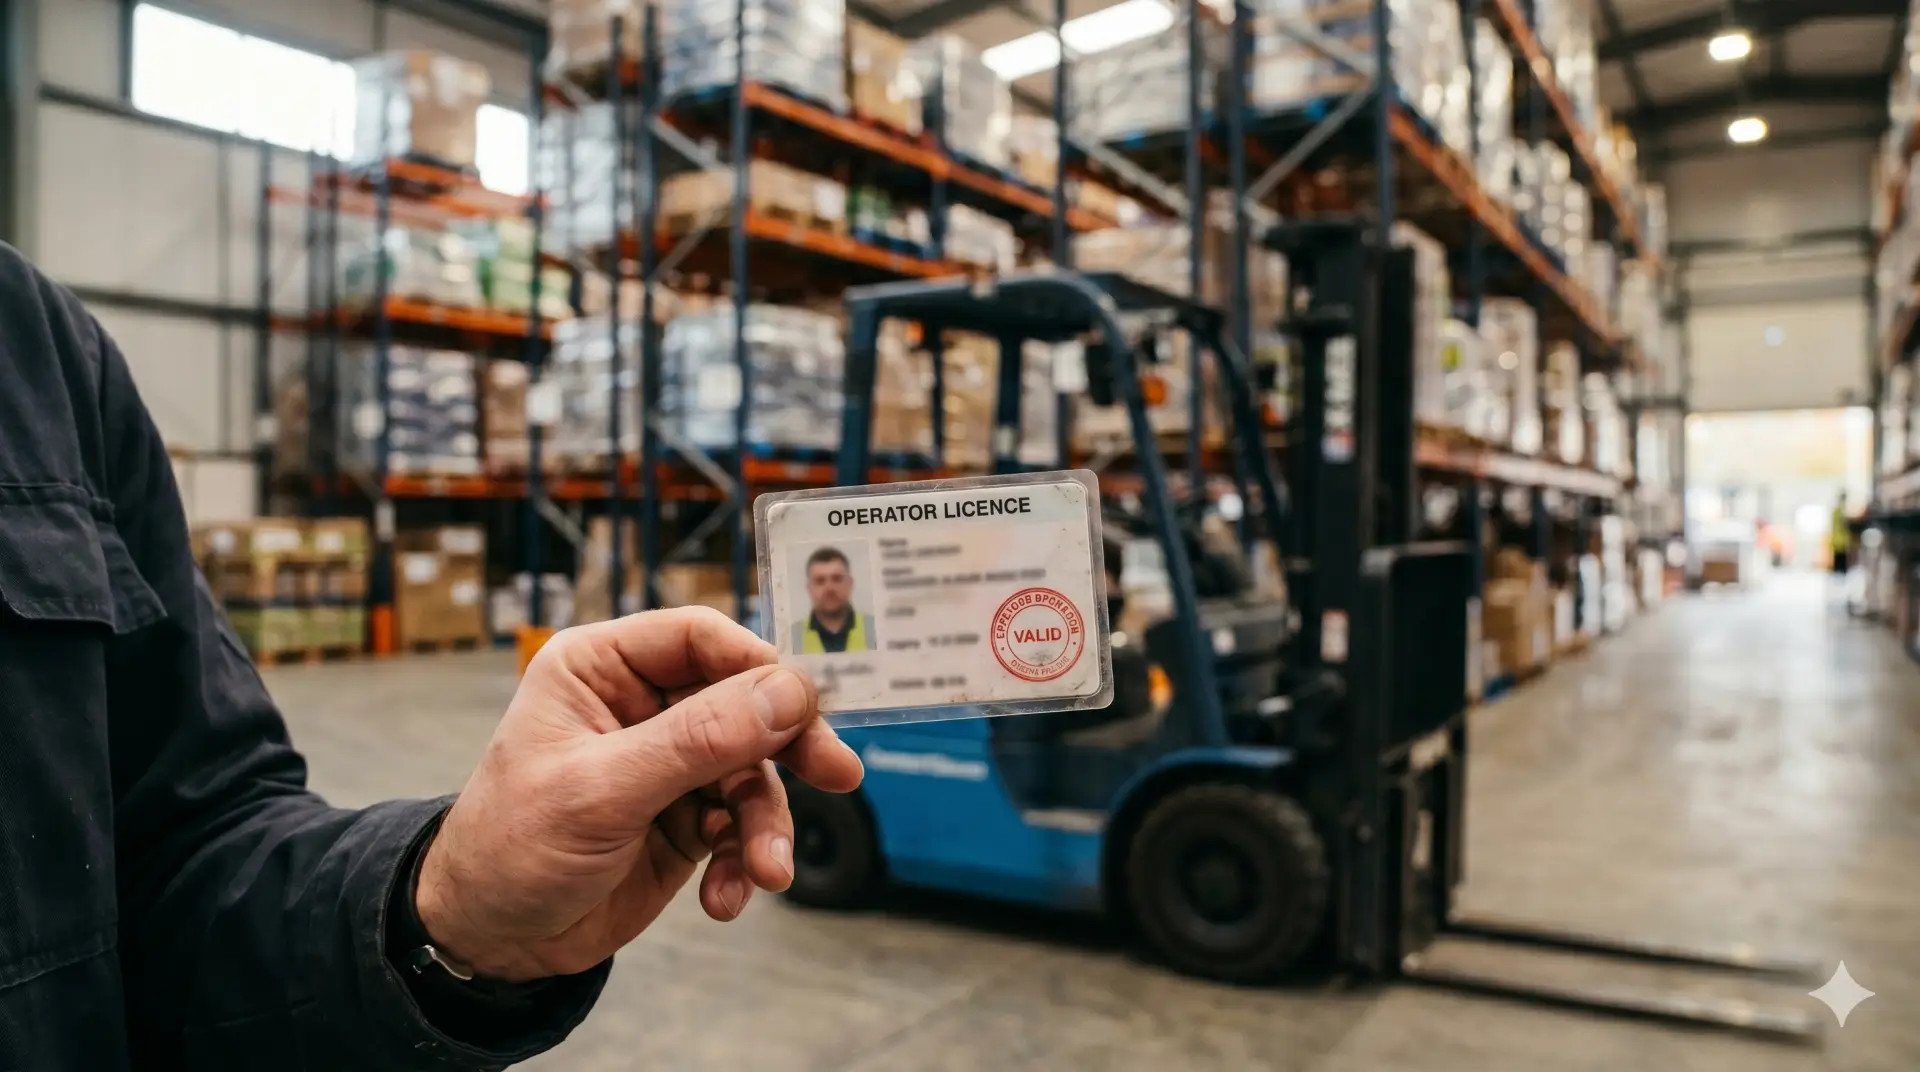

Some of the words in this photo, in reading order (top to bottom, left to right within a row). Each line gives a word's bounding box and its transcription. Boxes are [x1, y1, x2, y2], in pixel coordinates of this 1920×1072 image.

[827, 503, 938, 526] OPERATOR
[944, 496, 1031, 519] LICENCE
[1013, 627, 1062, 644] VALID
